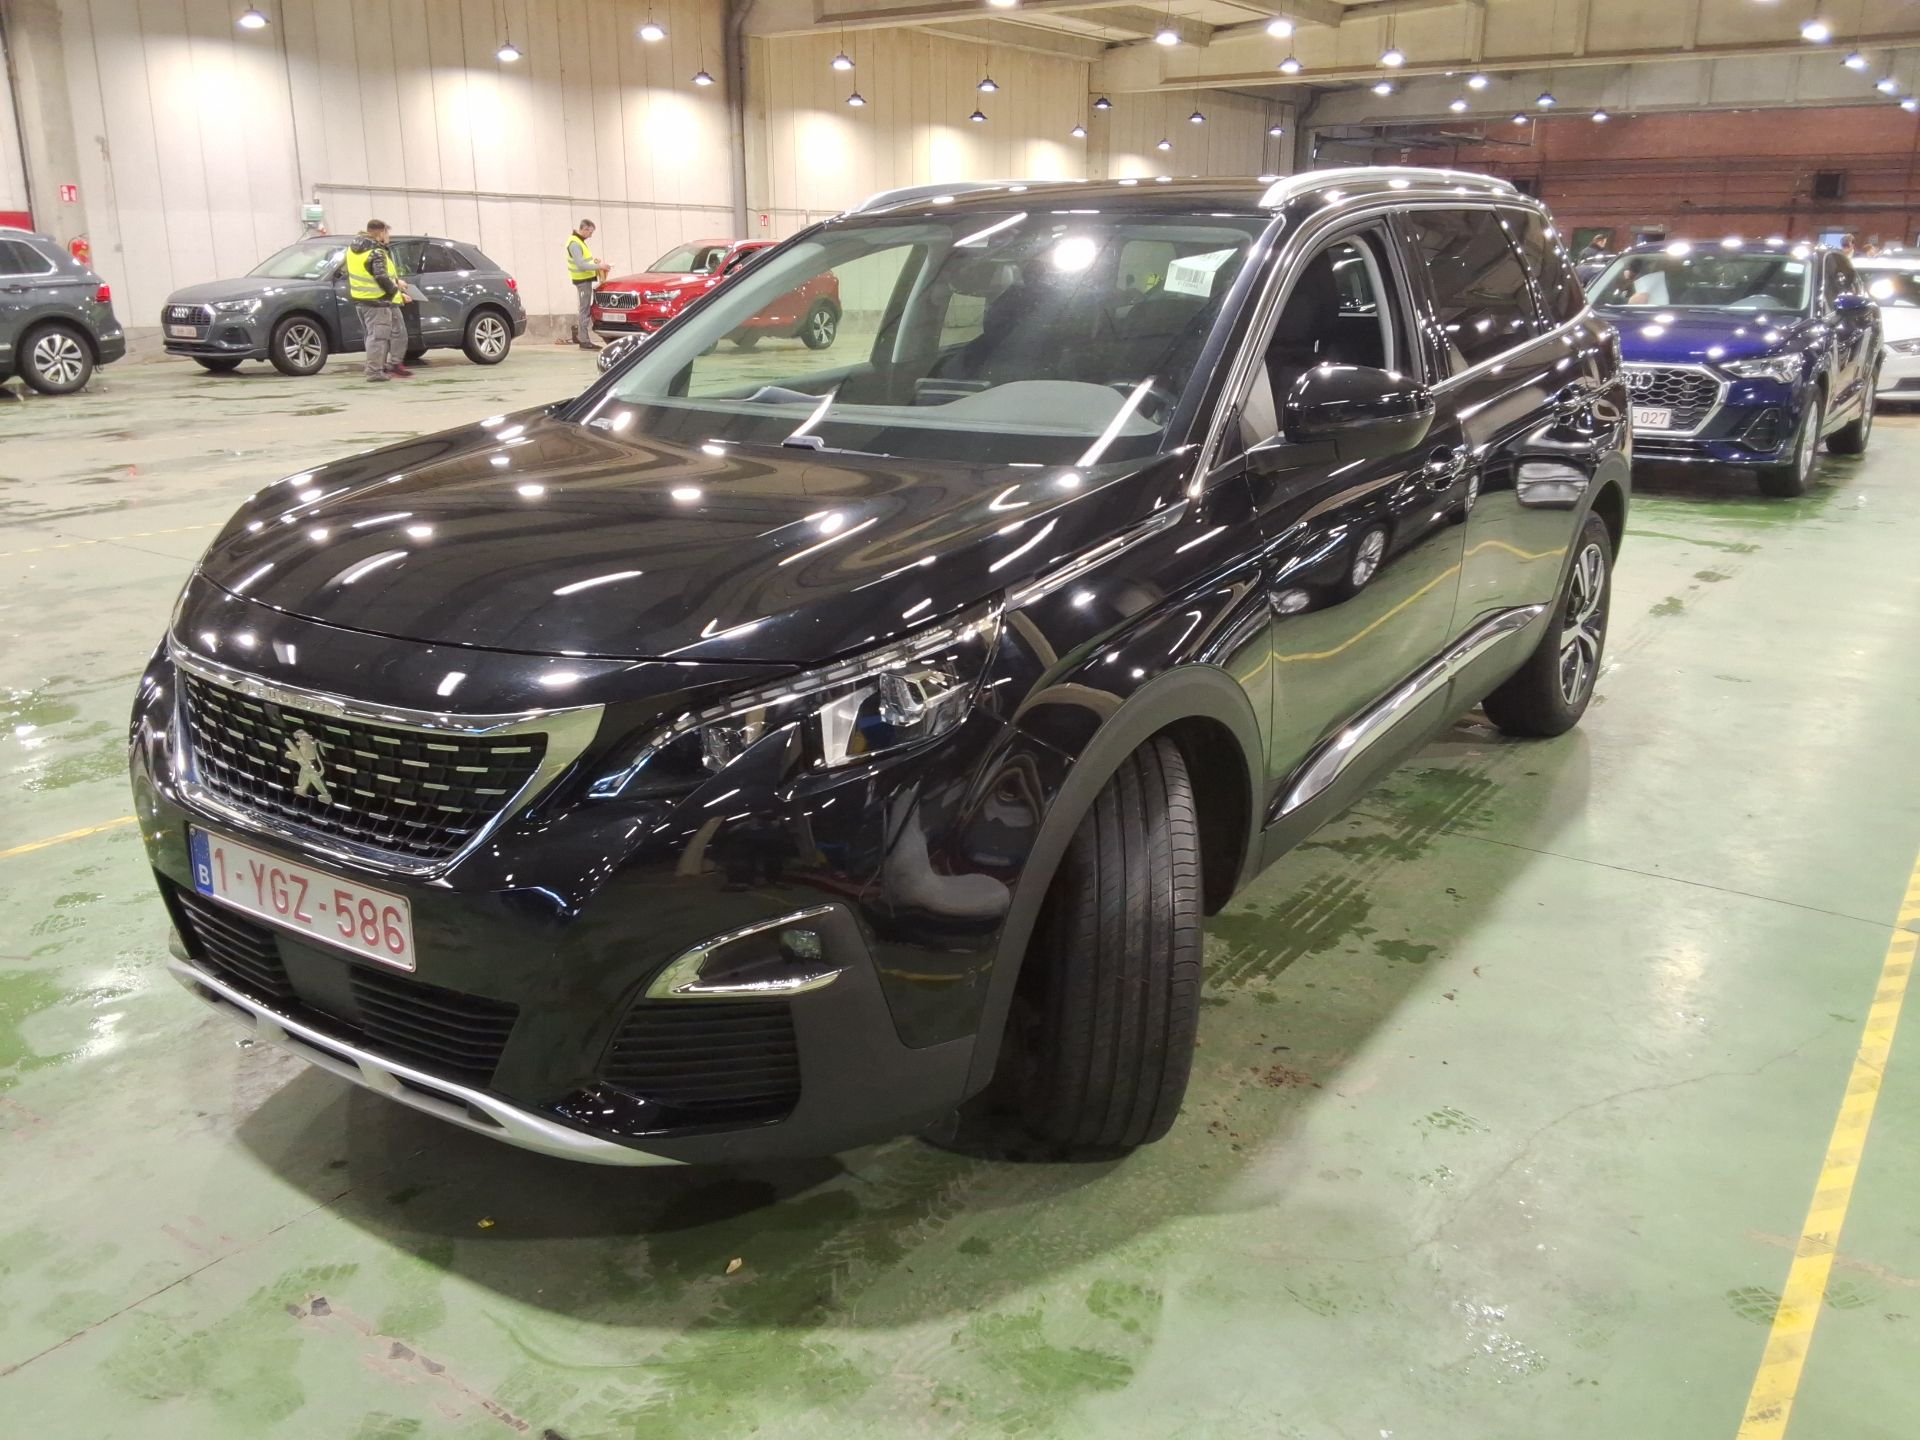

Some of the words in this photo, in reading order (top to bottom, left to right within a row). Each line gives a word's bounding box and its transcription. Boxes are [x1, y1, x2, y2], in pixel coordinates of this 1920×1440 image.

[247, 684, 327, 712] PEUGEOT
[199, 863, 210, 886] B
[214, 847, 405, 955] 1-YGZ-586
